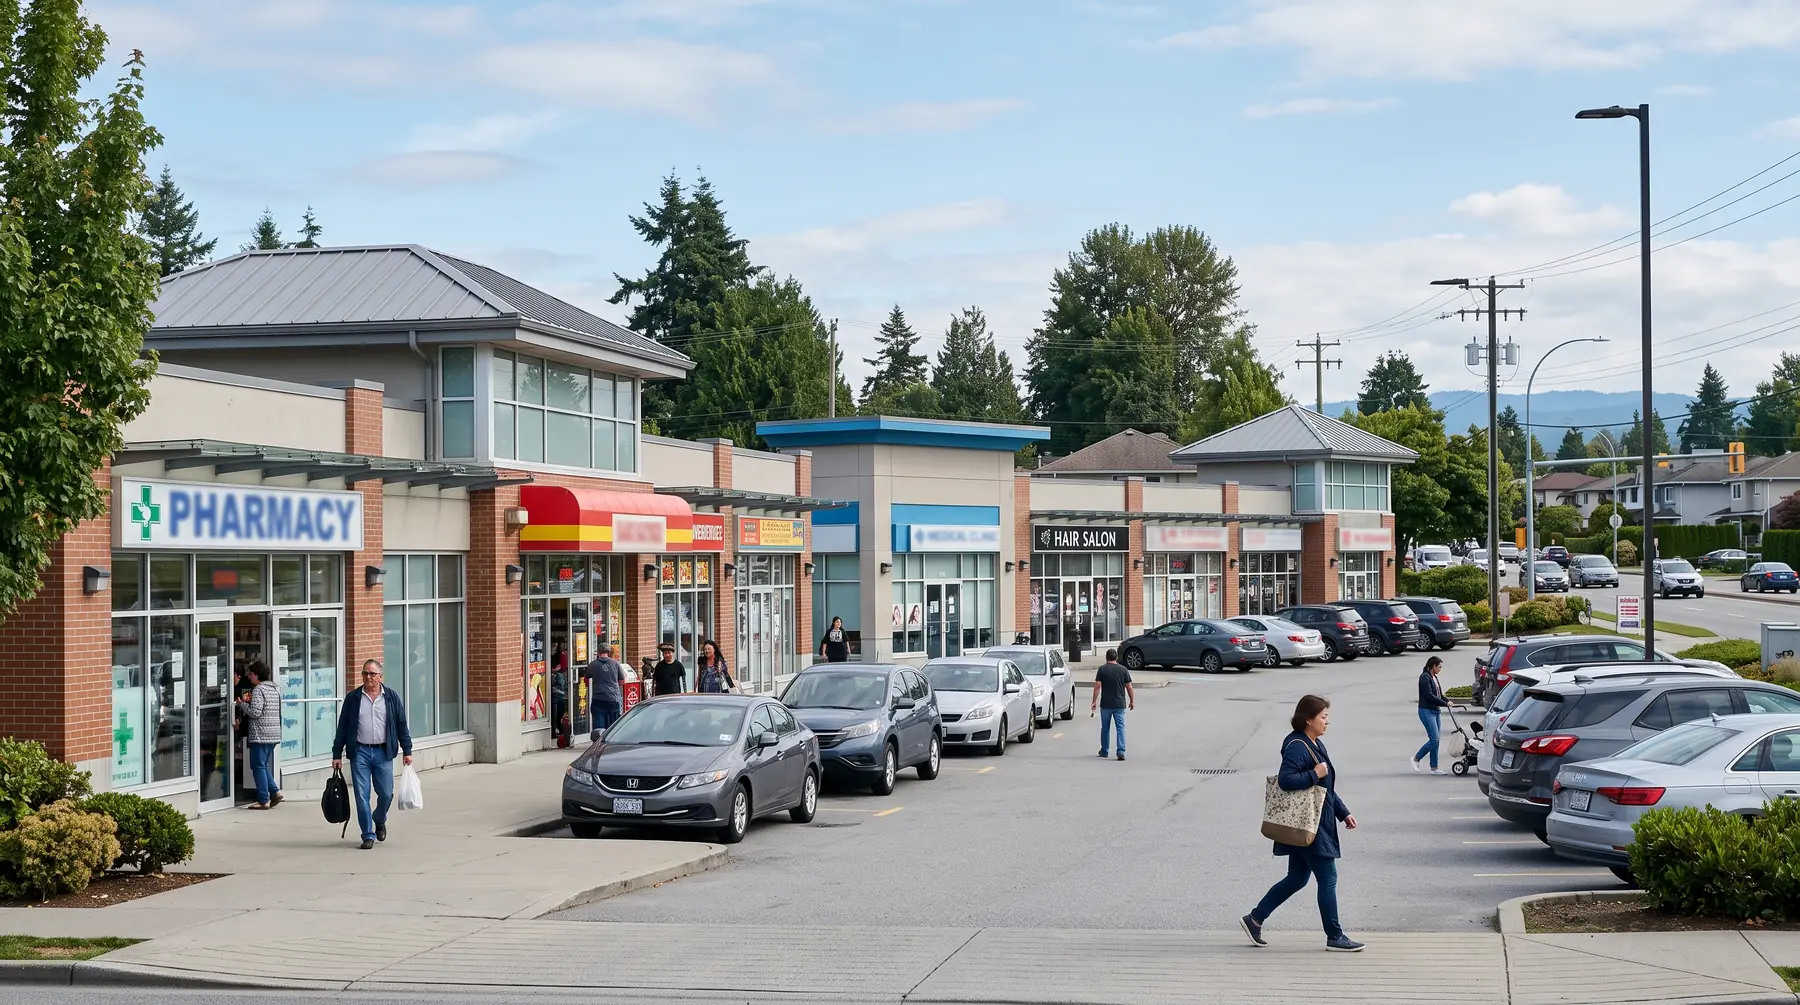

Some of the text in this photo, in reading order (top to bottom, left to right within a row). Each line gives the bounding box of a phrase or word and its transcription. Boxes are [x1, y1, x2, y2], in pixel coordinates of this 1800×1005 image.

[169, 490, 355, 541] PHARMACY
[1054, 530, 1116, 547] HAIR SALON
